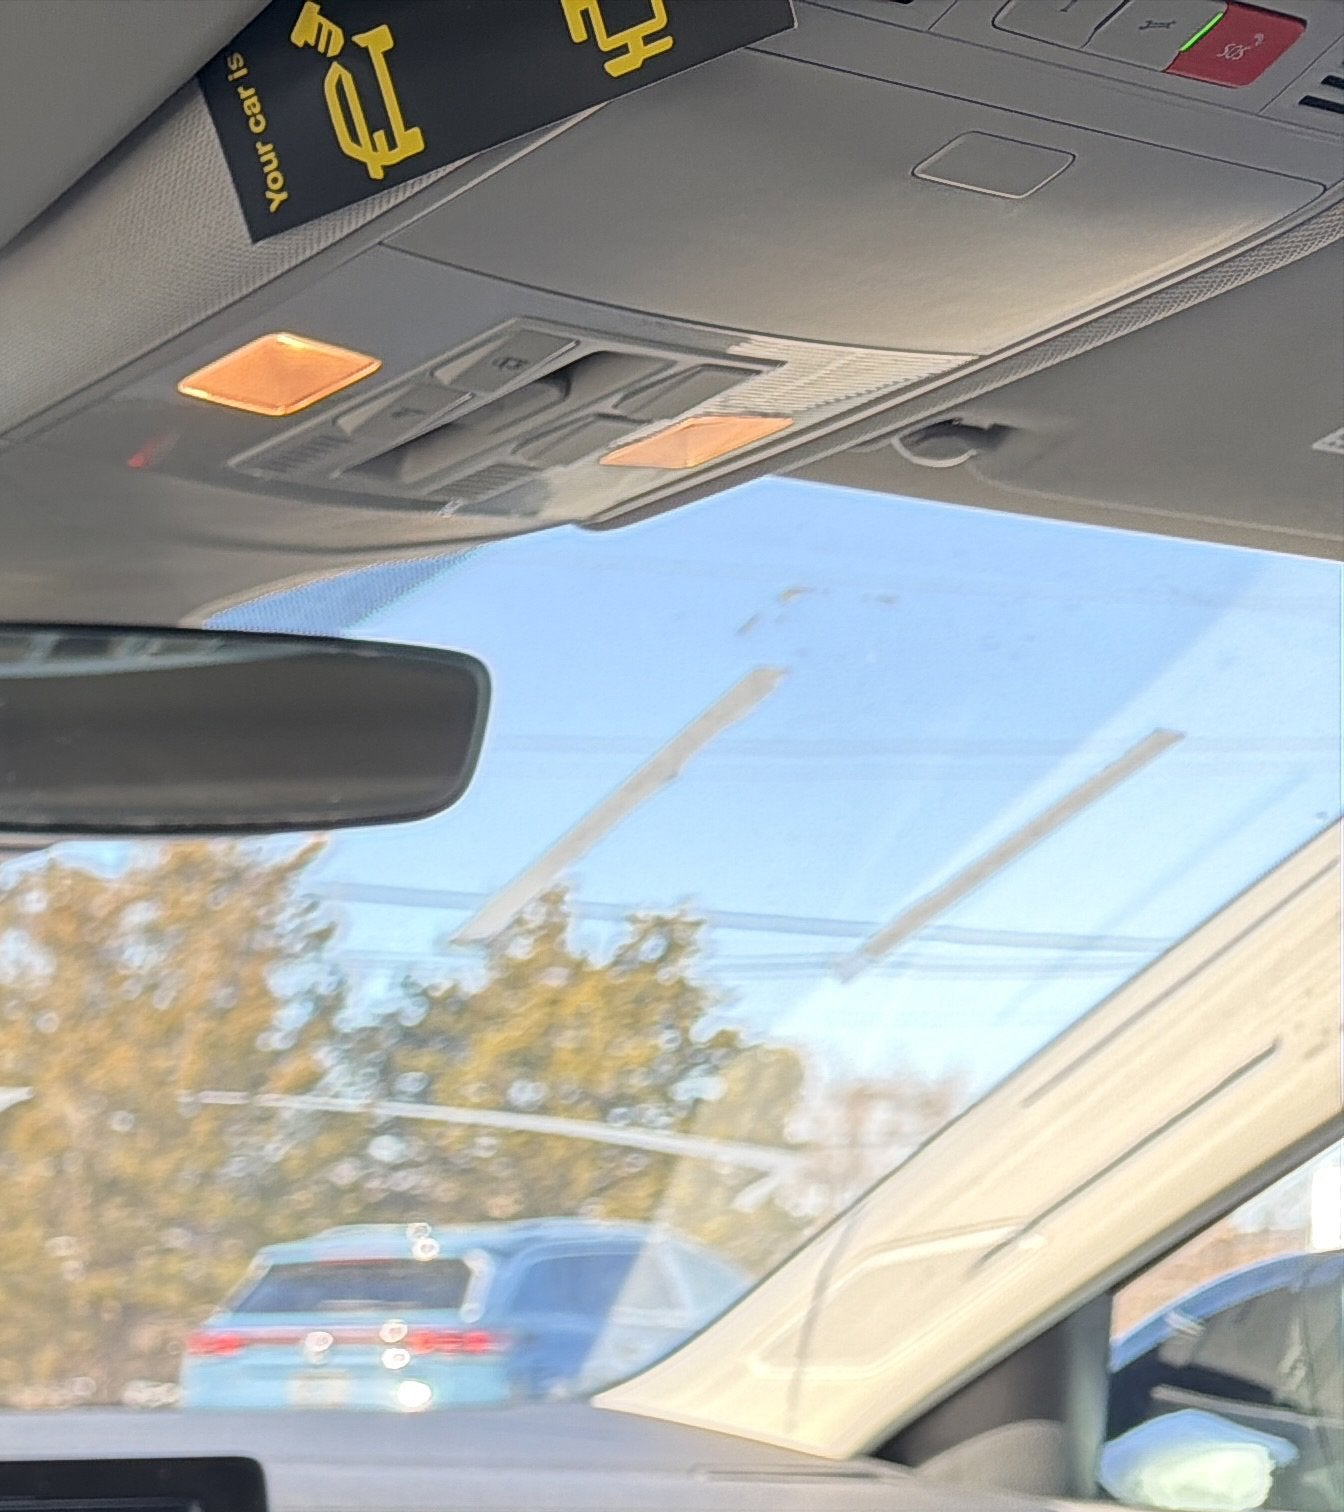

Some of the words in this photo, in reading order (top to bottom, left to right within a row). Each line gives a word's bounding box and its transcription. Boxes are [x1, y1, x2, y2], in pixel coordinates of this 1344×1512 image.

[226, 51, 245, 82] is
[237, 83, 267, 134] car
[255, 141, 289, 213] Your
